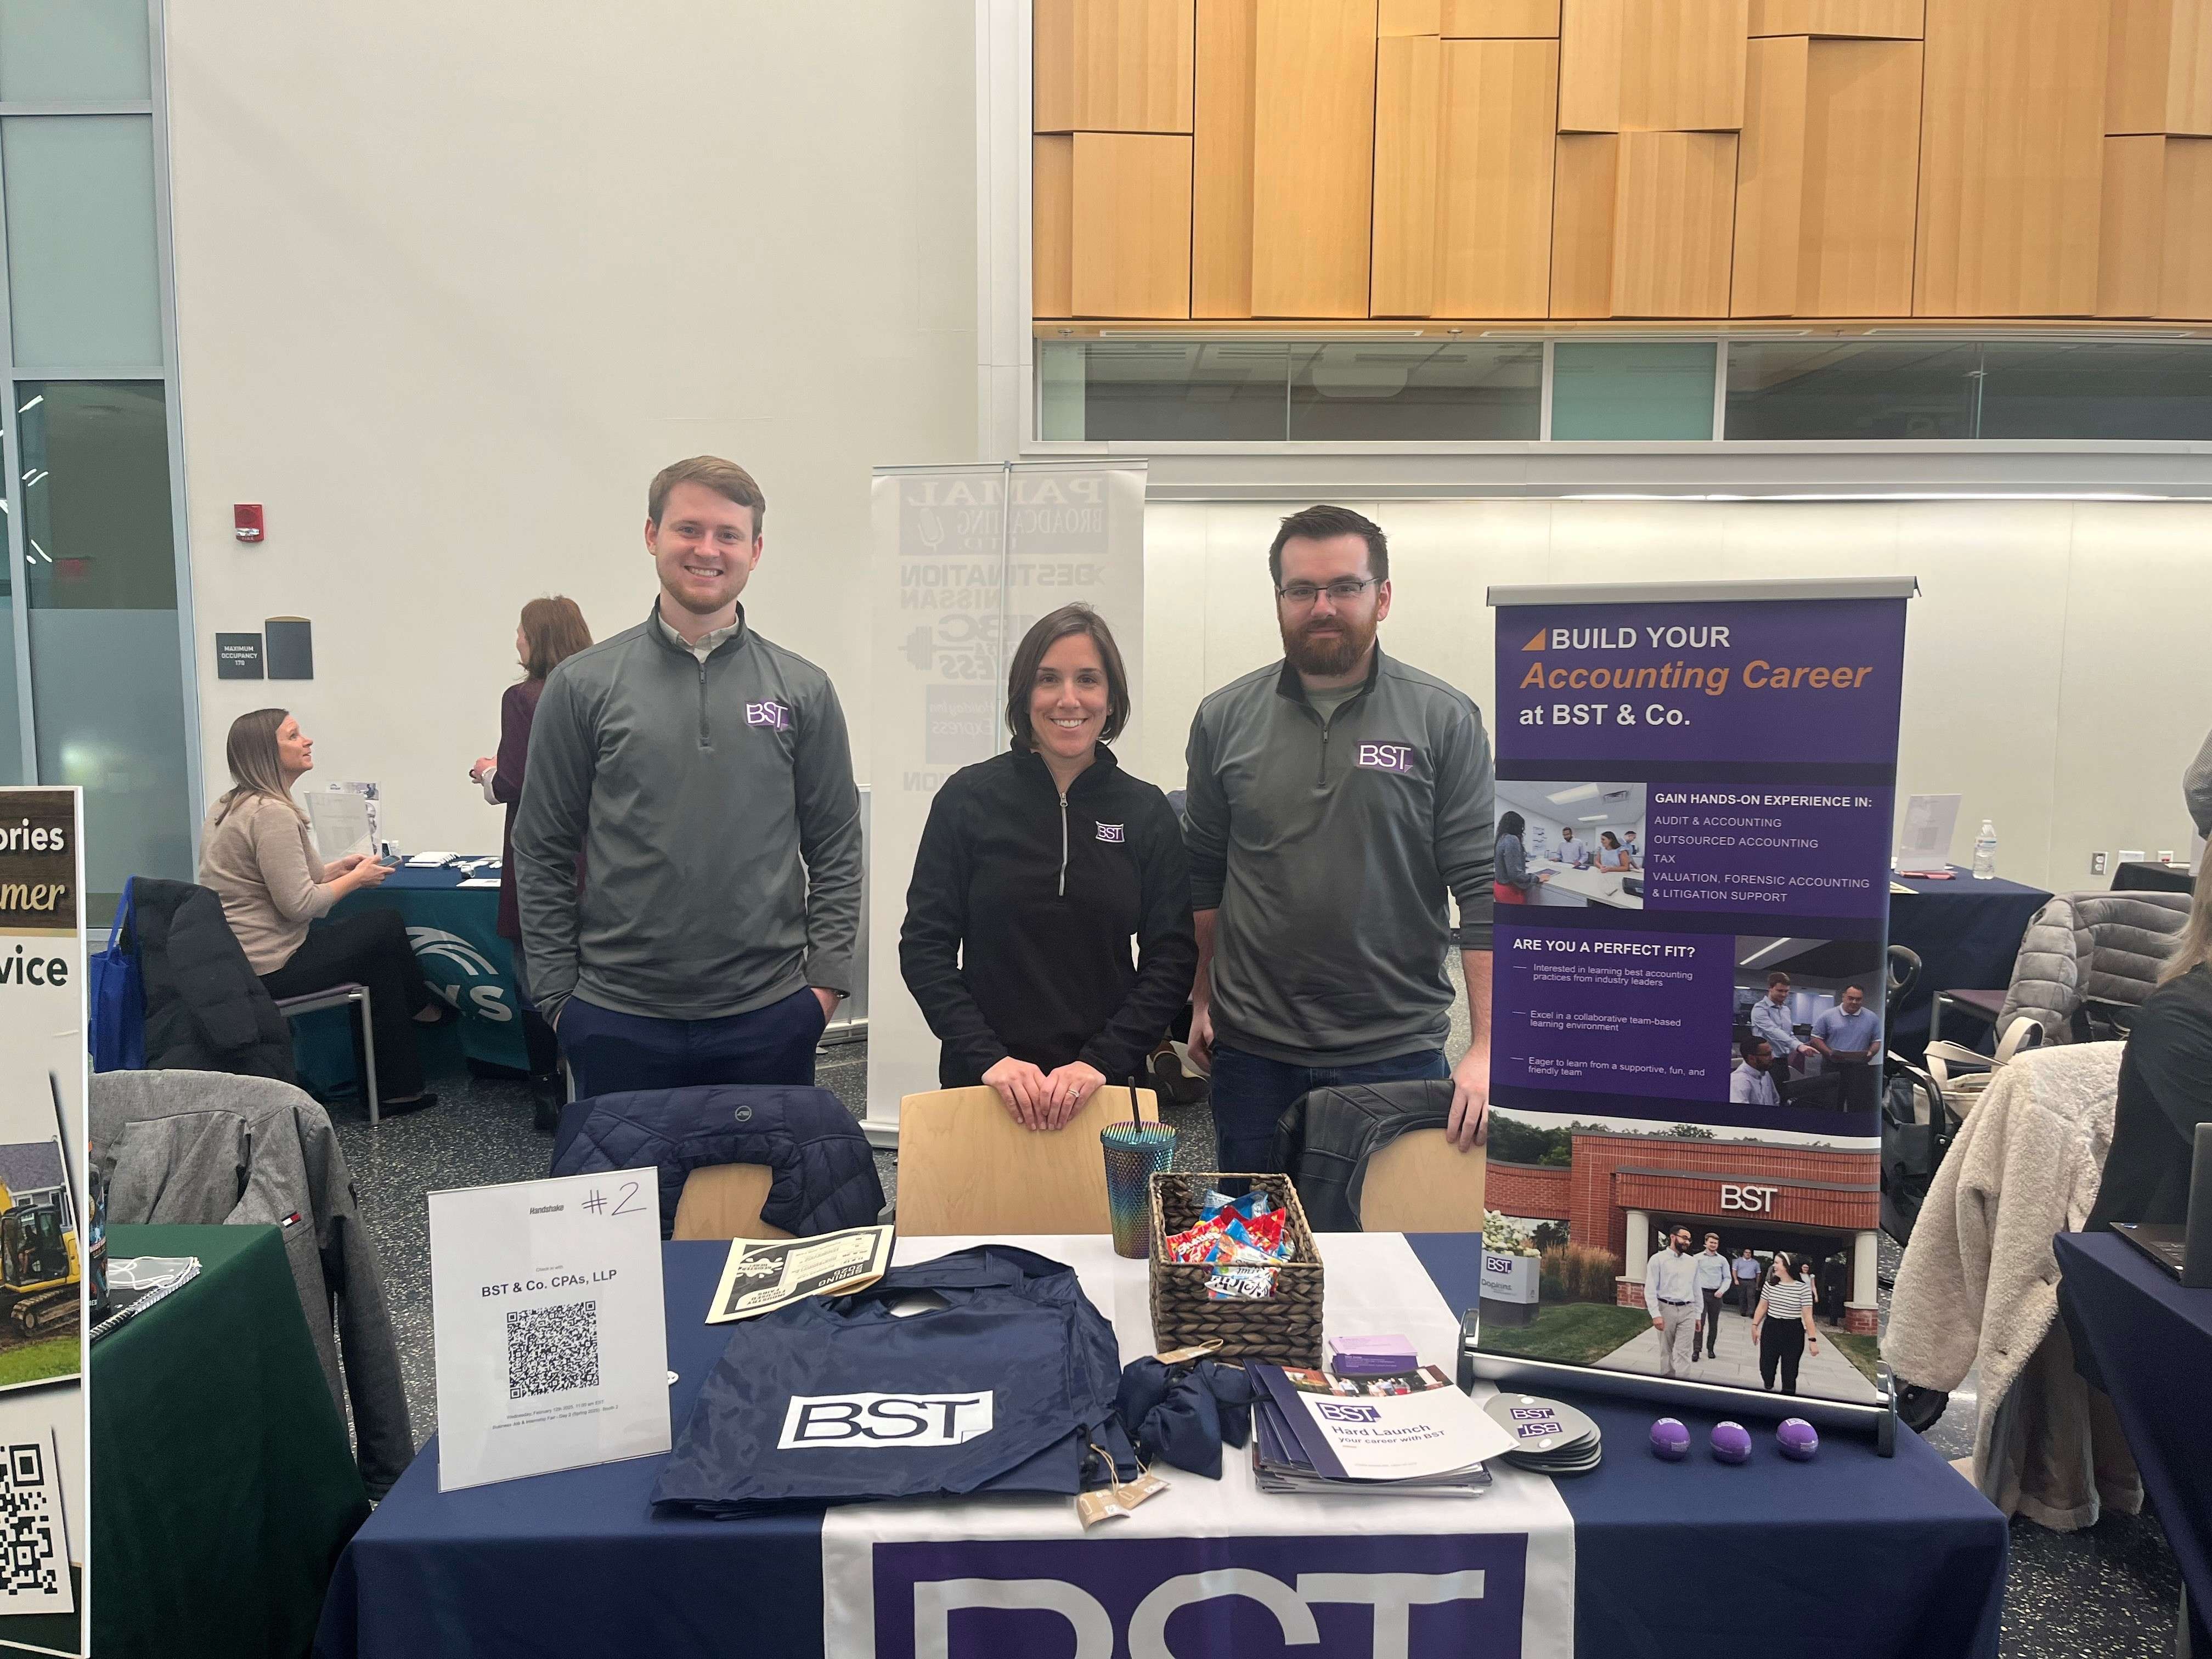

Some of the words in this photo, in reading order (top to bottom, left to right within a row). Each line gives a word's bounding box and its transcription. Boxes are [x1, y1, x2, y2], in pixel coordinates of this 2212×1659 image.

[1552, 627, 1637, 650] BUILD
[1646, 627, 1730, 648] YOUR
[1519, 661, 1729, 696] Accounting
[1743, 660, 1874, 689] Career
[746, 702, 788, 727] BST
[1519, 704, 1544, 725] at
[1553, 704, 1609, 725] BST
[1616, 704, 1637, 725] &
[1645, 704, 1691, 725] Co.
[1359, 745, 1411, 769] BST
[1655, 793, 1686, 804] GAIN
[1691, 794, 1760, 805] HANDS-ON
[1764, 795, 1850, 807] EXPERIENCE
[1854, 797, 1872, 807] IN:
[1654, 816, 1689, 825] AUDIT
[1692, 817, 1700, 825] &
[1703, 817, 1782, 827] ACCOUNTING
[1098, 825, 1121, 839] BST
[1654, 835, 1735, 845] OUTSOURCED
[1738, 837, 1819, 848] ACCOUNTING
[1654, 854, 1675, 864] TAX
[1652, 872, 1721, 884] VALUATION,
[1725, 874, 1785, 885] FORENSIC
[1788, 877, 1870, 888] ACCOUNTING
[1652, 888, 1660, 898] &
[1663, 889, 1728, 900] LITIGATION
[1731, 891, 1788, 902] SUPPORT
[1513, 938, 1542, 951] ARE
[1545, 940, 1576, 952] YOU
[1579, 942, 1590, 953] A
[1594, 942, 1661, 956] PERFECT
[1664, 945, 1696, 958] FIT?
[1533, 963, 1576, 973] Interested
[1588, 966, 1622, 977] learning
[1625, 968, 1643, 977] best
[1645, 969, 1693, 980] accounting
[1533, 973, 1571, 981] practices
[1573, 974, 1592, 983] from
[1595, 975, 1629, 986] industry
[1631, 978, 1663, 986] leaders
[1530, 1010, 1554, 1019] Excel
[1573, 1013, 1627, 1023] collaborative
[1630, 1017, 1681, 1027] team-based
[1530, 1019, 1564, 1030] learning
[1566, 1022, 1619, 1031] environment
[1528, 1066, 1559, 1076] friendly
[1529, 1057, 1554, 1067] Eager
[1566, 1059, 1588, 1068] learn
[1590, 1060, 1609, 1069] from
[1620, 1063, 1667, 1074] supportive,
[1669, 1066, 1685, 1076] fun,
[1689, 1068, 1705, 1076] and
[582, 1182, 647, 1215] #2
[1721, 1184, 1778, 1212] BST
[529, 1204, 565, 1215] Handshake
[1487, 1257, 1511, 1272] BST
[482, 1283, 509, 1297] BST
[512, 1282, 522, 1292] &
[526, 1280, 548, 1290] Co.
[551, 1274, 589, 1287] CPAs,
[593, 1269, 617, 1282] LLP
[1320, 1404, 1374, 1422] BST
[1512, 1409, 1550, 1418] BST
[793, 1400, 980, 1442] BST
[1331, 1426, 1369, 1436] Hard
[1372, 1424, 1431, 1436] Launch
[1424, 1430, 1446, 1440] BST
[1521, 1423, 1560, 1437] BST
